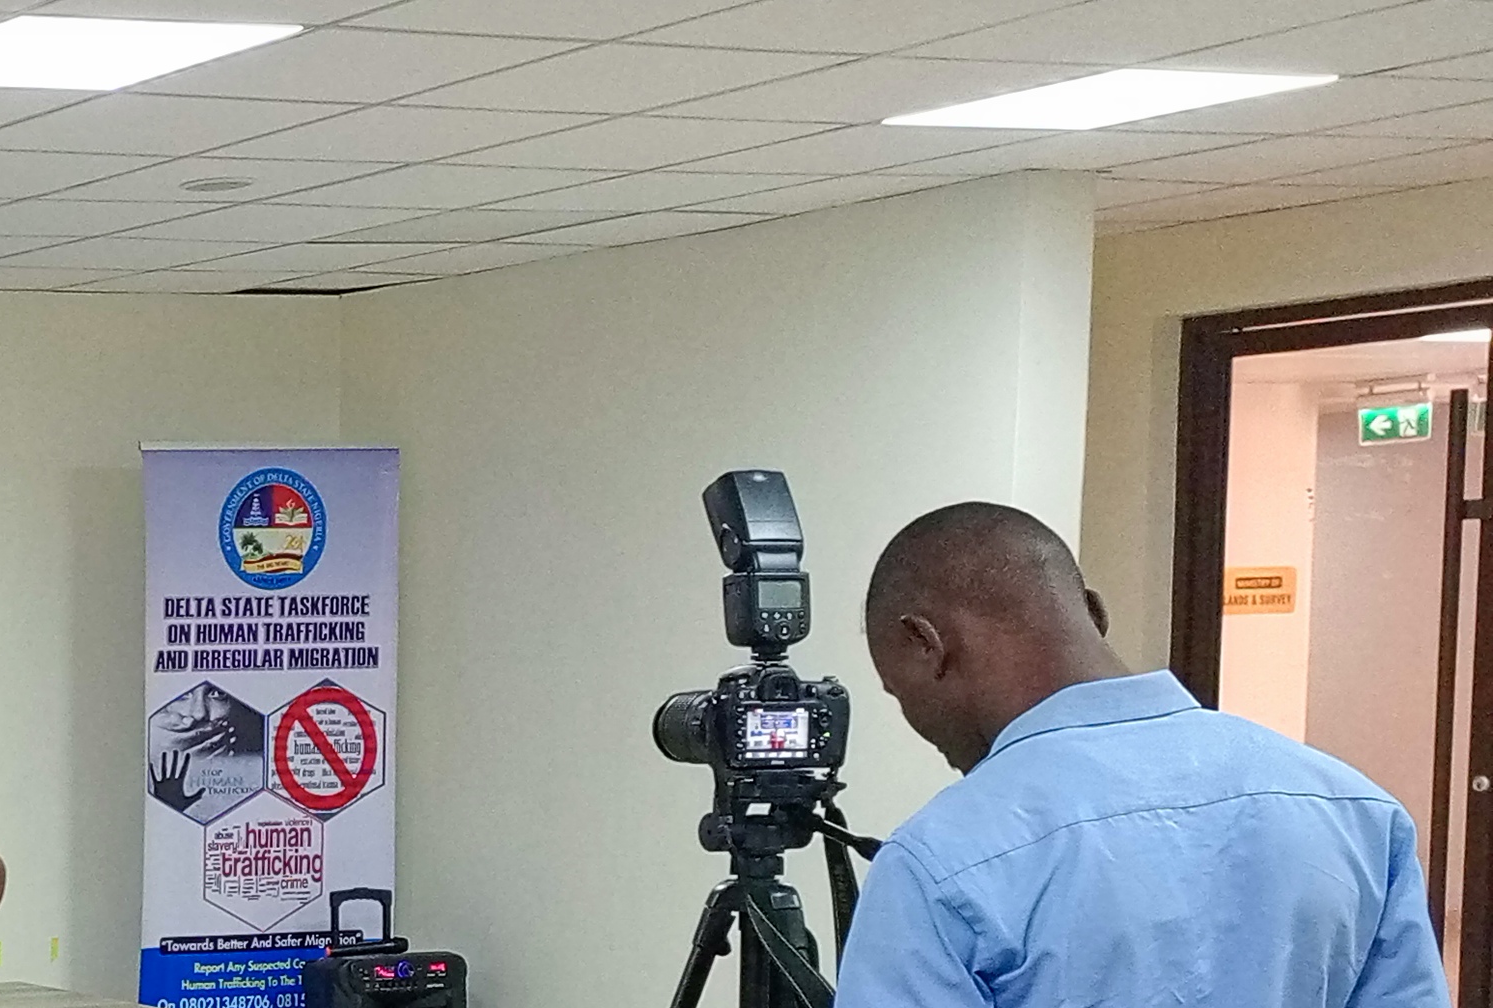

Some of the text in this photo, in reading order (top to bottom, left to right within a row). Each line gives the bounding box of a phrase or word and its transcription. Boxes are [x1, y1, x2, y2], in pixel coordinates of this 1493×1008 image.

[164, 594, 370, 620] DELTA STATE TASKFORCE
[167, 621, 365, 645] ON HUMAN TRAFFICKING
[155, 647, 379, 672] AND IRREGULAR MIGRATION
[245, 821, 311, 849] human
[207, 840, 238, 852] slavery
[222, 849, 323, 883] trafficking
[281, 877, 309, 889] crime
[217, 937, 248, 950] Better
[251, 937, 273, 949] And
[275, 934, 303, 948] Safer
[194, 962, 225, 976] Report
[226, 960, 246, 975] Any
[248, 958, 291, 972] Suspected
[181, 979, 216, 990] Human
[218, 976, 265, 993] Trafficking
[267, 976, 278, 987] To
[280, 975, 295, 986] The
